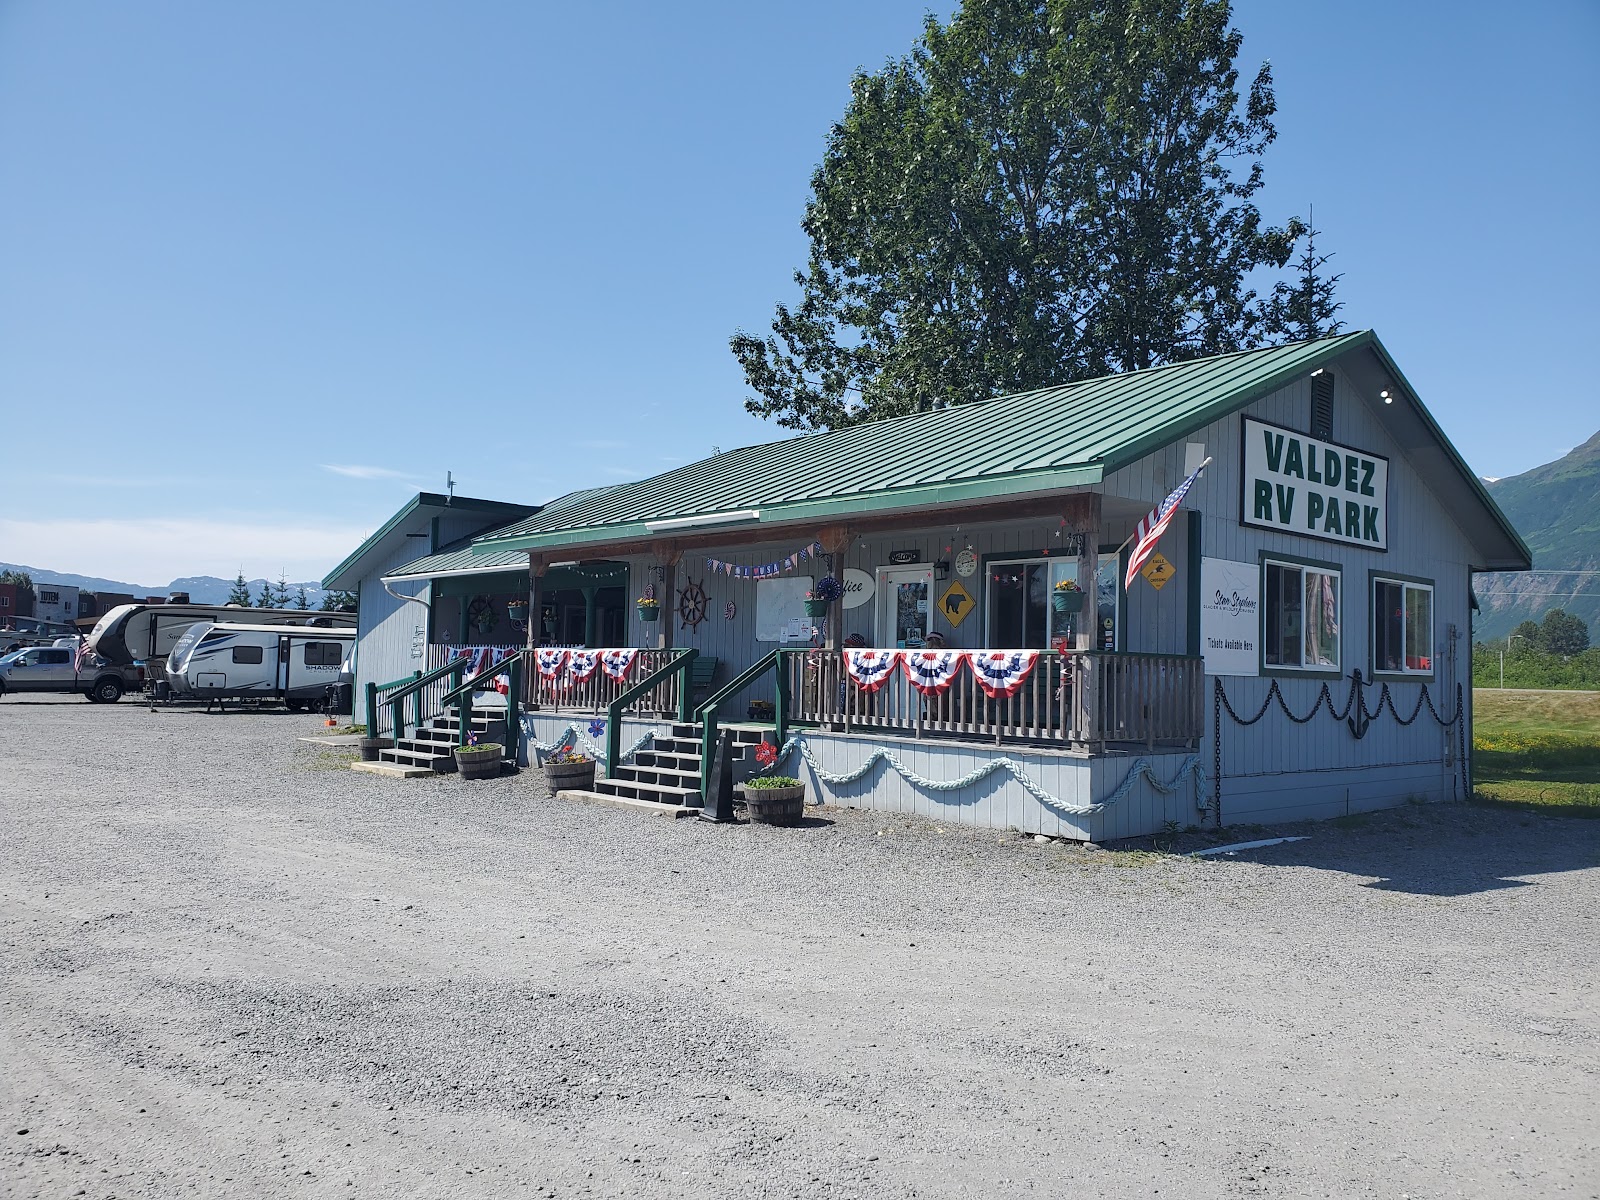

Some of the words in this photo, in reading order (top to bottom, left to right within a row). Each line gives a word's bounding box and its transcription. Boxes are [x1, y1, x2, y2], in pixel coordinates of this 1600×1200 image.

[1264, 430, 1375, 497] VALDEZ
[1254, 479, 1295, 524] RV
[1307, 491, 1379, 542] PARK
[760, 564, 778, 575] USA
[1208, 638, 1223, 648] Tickets
[1225, 639, 1242, 649] Available
[1244, 640, 1253, 650] Here
